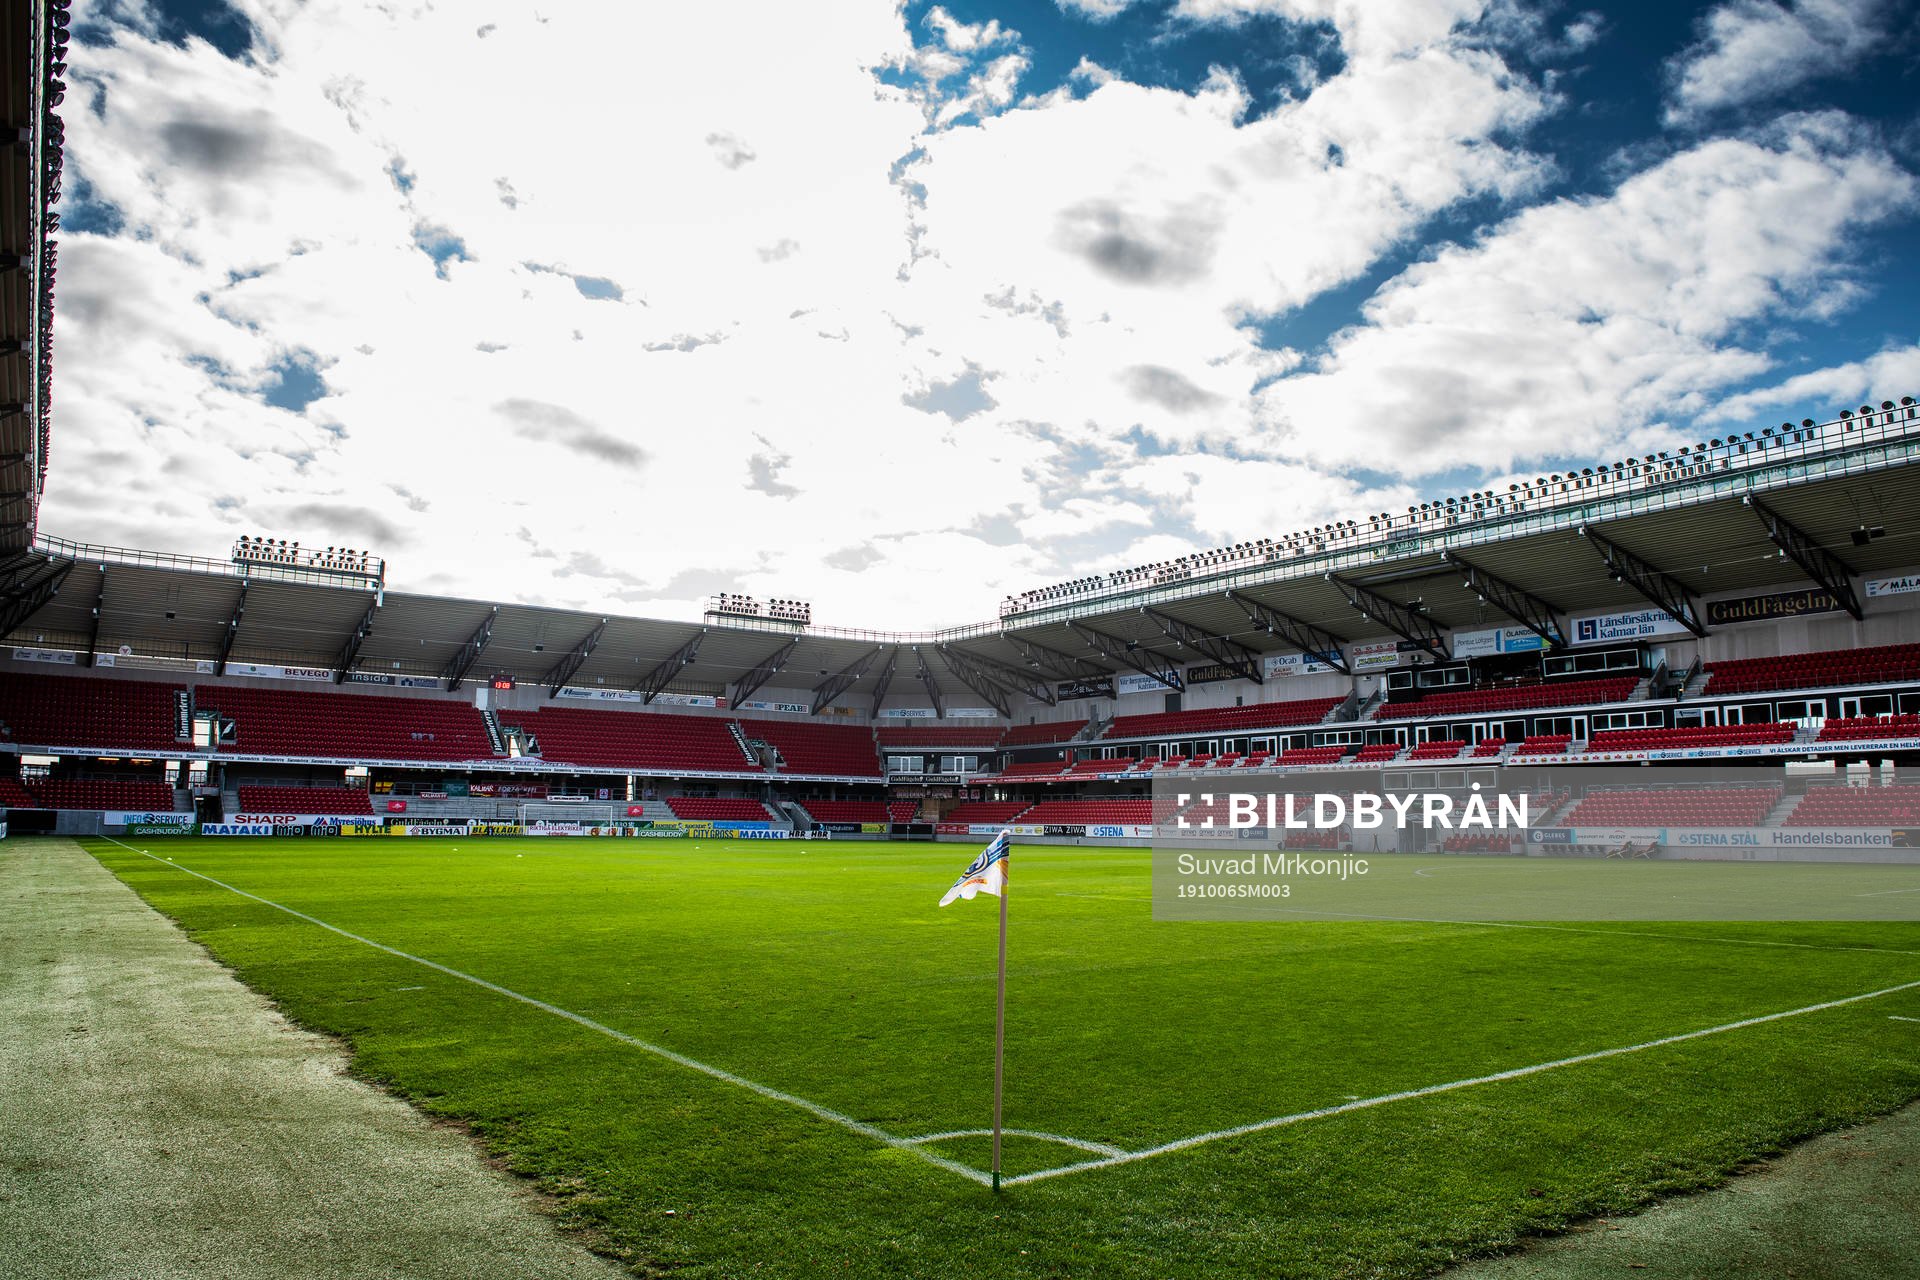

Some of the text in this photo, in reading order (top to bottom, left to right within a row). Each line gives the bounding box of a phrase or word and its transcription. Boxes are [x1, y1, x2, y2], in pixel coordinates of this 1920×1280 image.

[1712, 592, 1827, 621] GuldFågeln
[1600, 611, 1675, 628] Länsförsäkring
[1600, 624, 1655, 639] Kalmar län
[284, 668, 329, 679] BEVEGO
[124, 814, 188, 824] INFO SERVICE
[234, 814, 297, 824] SHARP
[202, 824, 270, 835] MATAKI
[355, 825, 392, 834] HYLTE
[421, 827, 461, 835] BYGMA
[640, 830, 682, 838] CASHBUDDY
[693, 829, 734, 839] CITY GROSS
[739, 831, 783, 839] MATAKI
[1099, 826, 1124, 837] STENA
[1690, 831, 1760, 845] STENA STÅL
[1773, 832, 1892, 845] Handelsbanken
